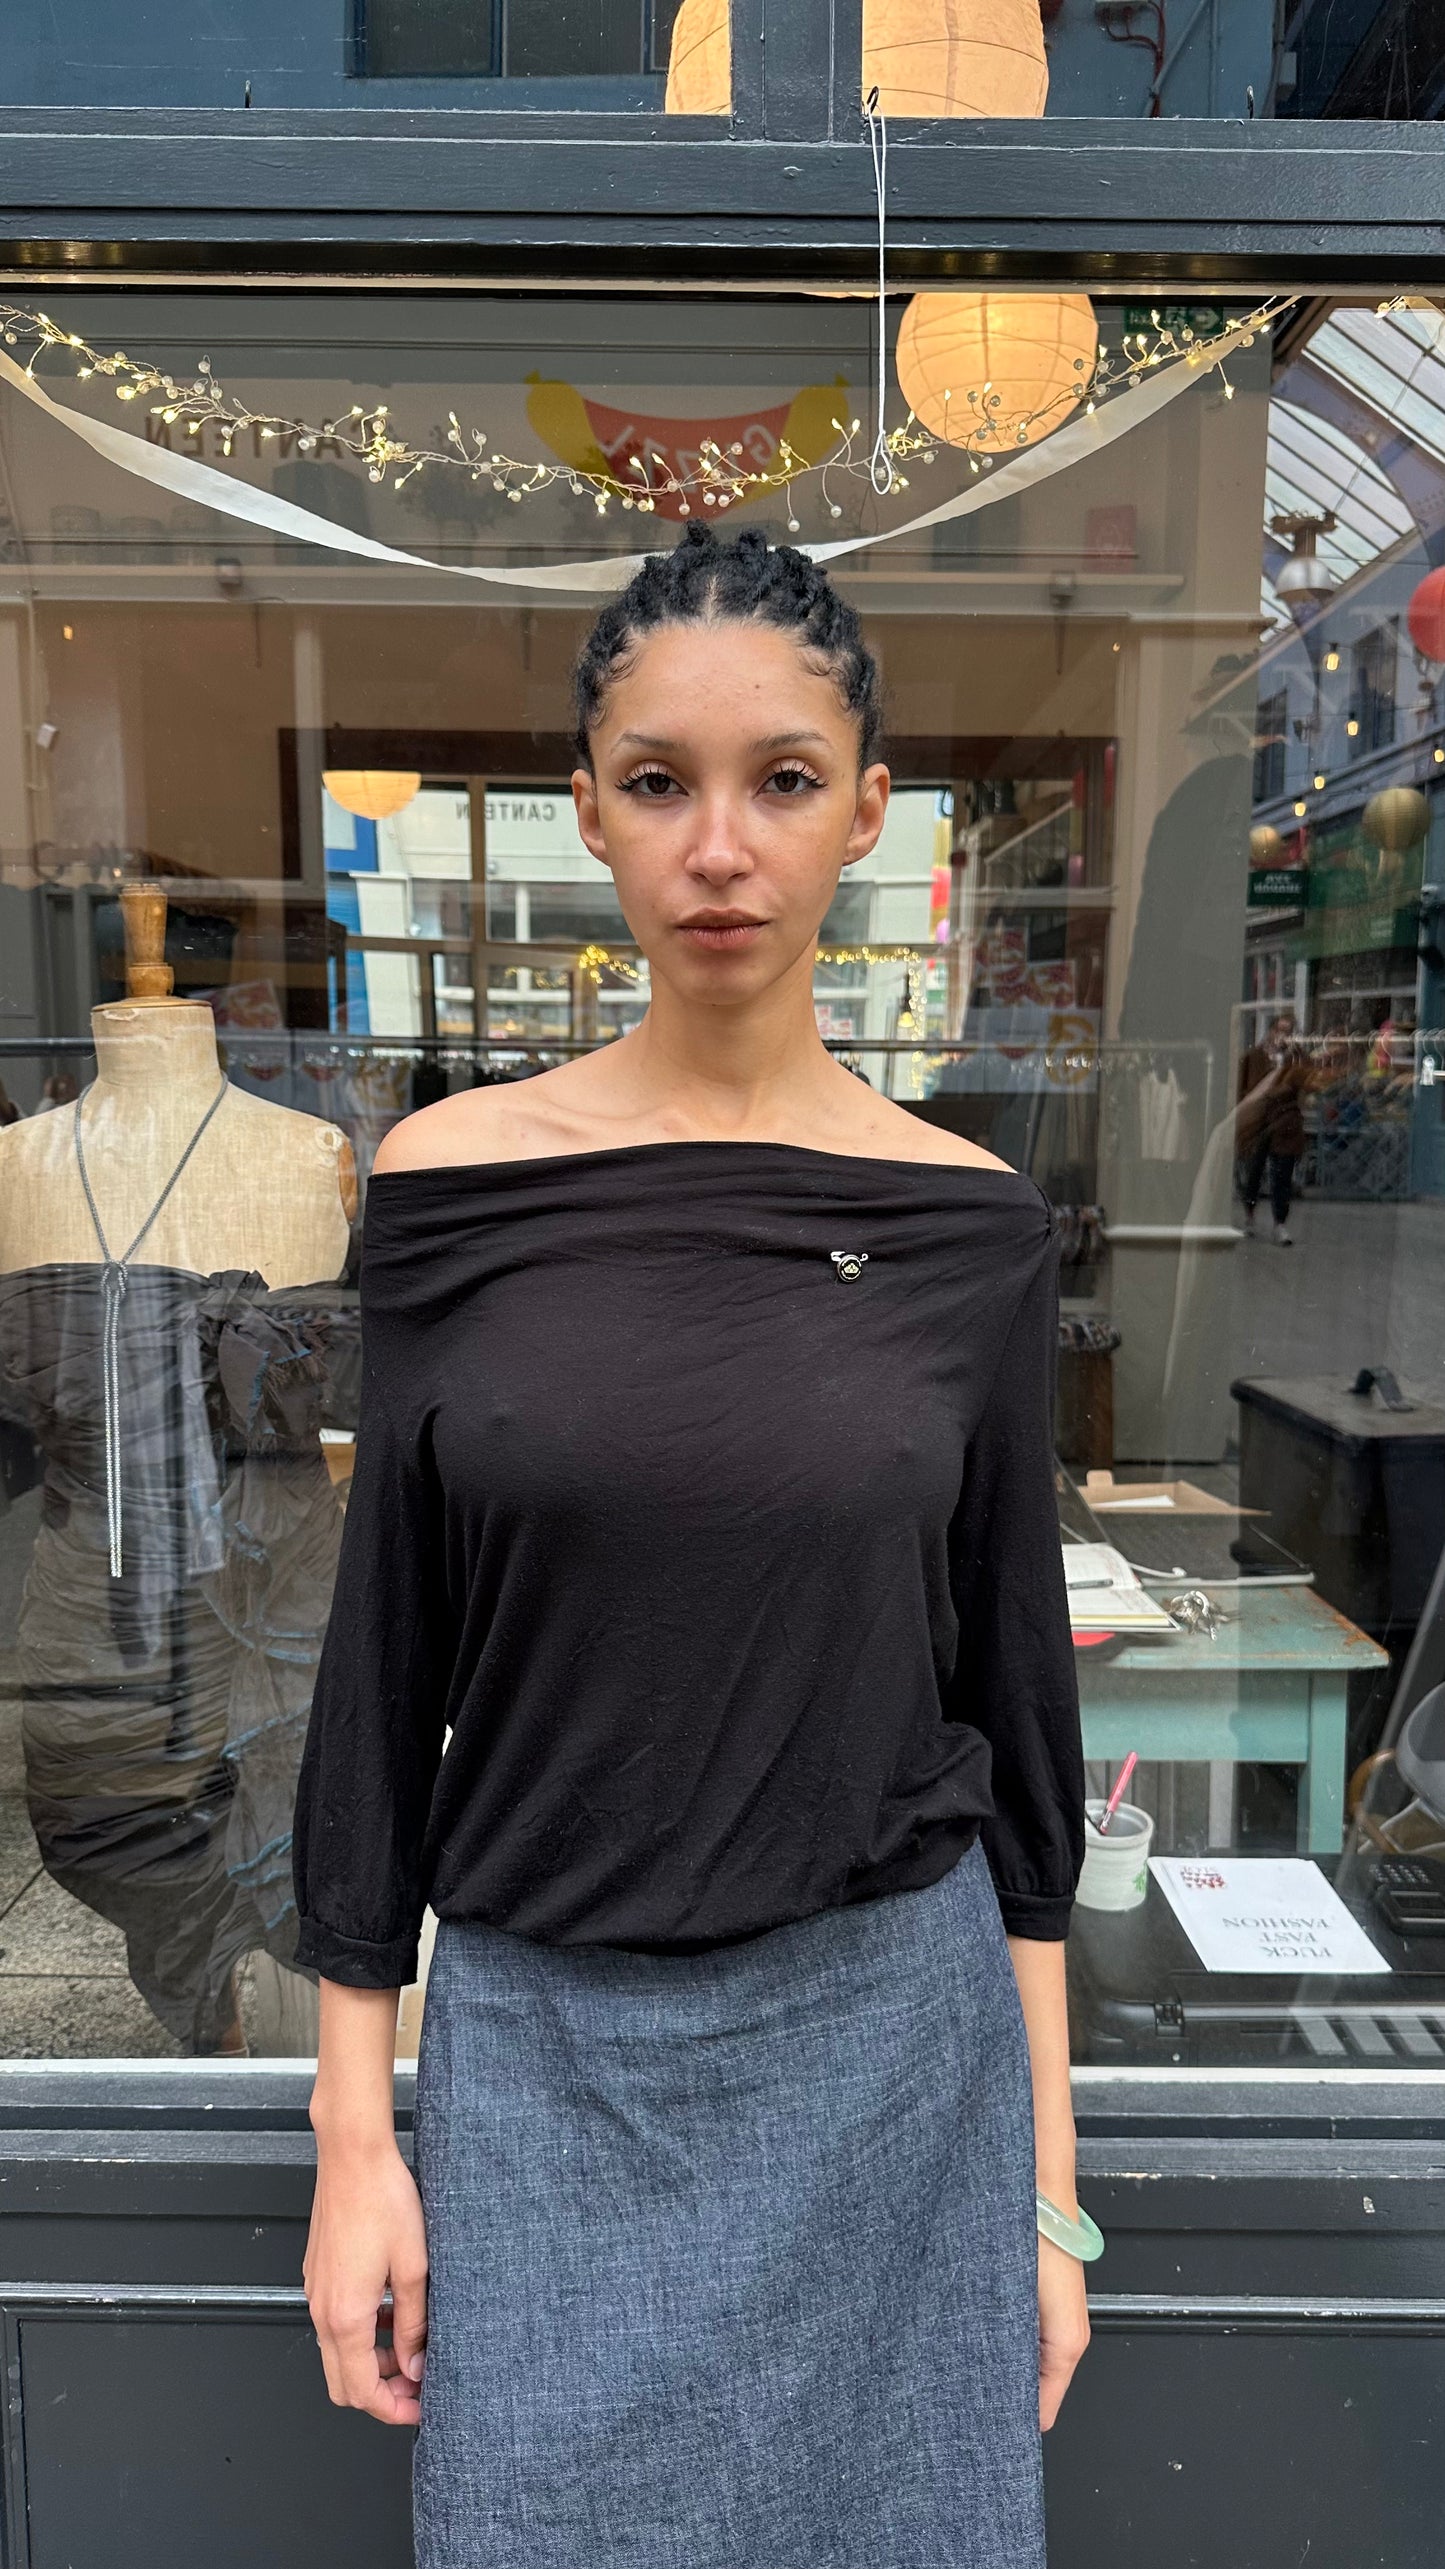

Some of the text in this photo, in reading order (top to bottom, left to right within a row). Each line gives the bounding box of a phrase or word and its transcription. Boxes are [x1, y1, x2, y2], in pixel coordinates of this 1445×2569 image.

[1222, 1916, 1331, 1930] FASHION
[1260, 1931, 1320, 1944] FAST
[1260, 1946, 1333, 1959] FUCK
